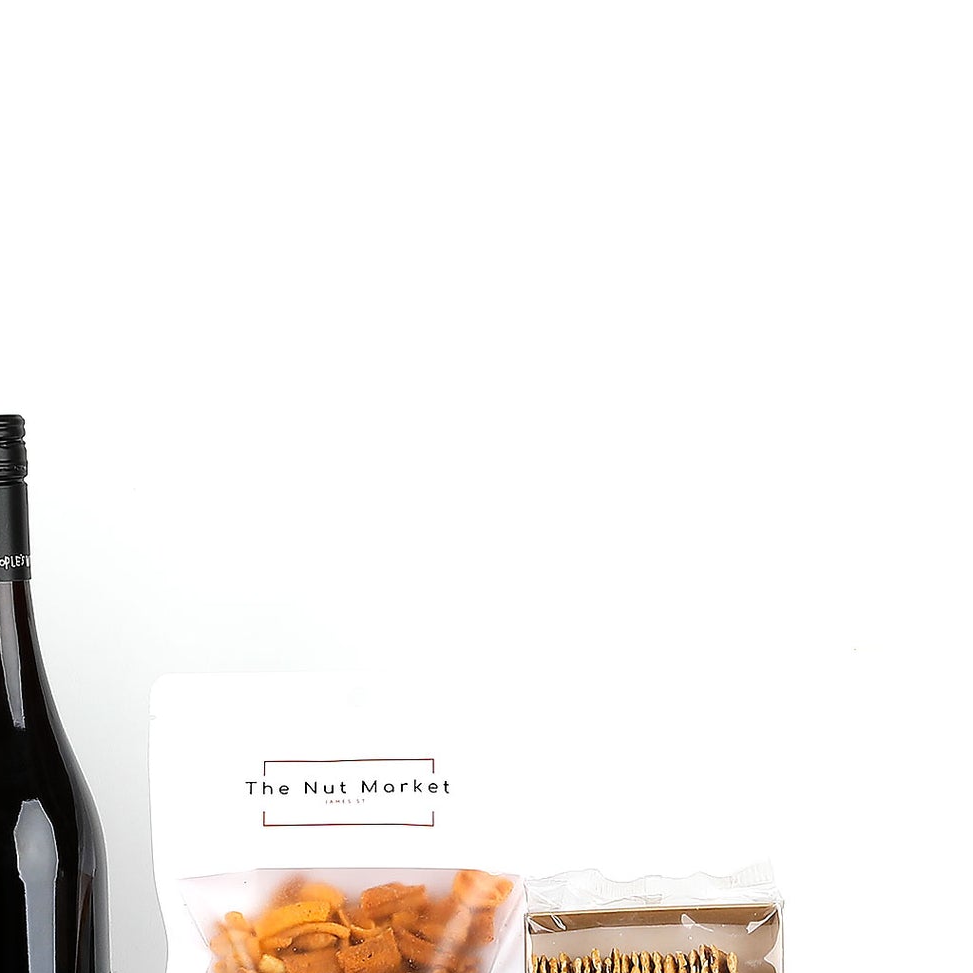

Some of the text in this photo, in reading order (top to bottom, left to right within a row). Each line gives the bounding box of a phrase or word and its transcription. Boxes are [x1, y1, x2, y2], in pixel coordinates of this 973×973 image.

[245, 779, 450, 795] The Nut Market
